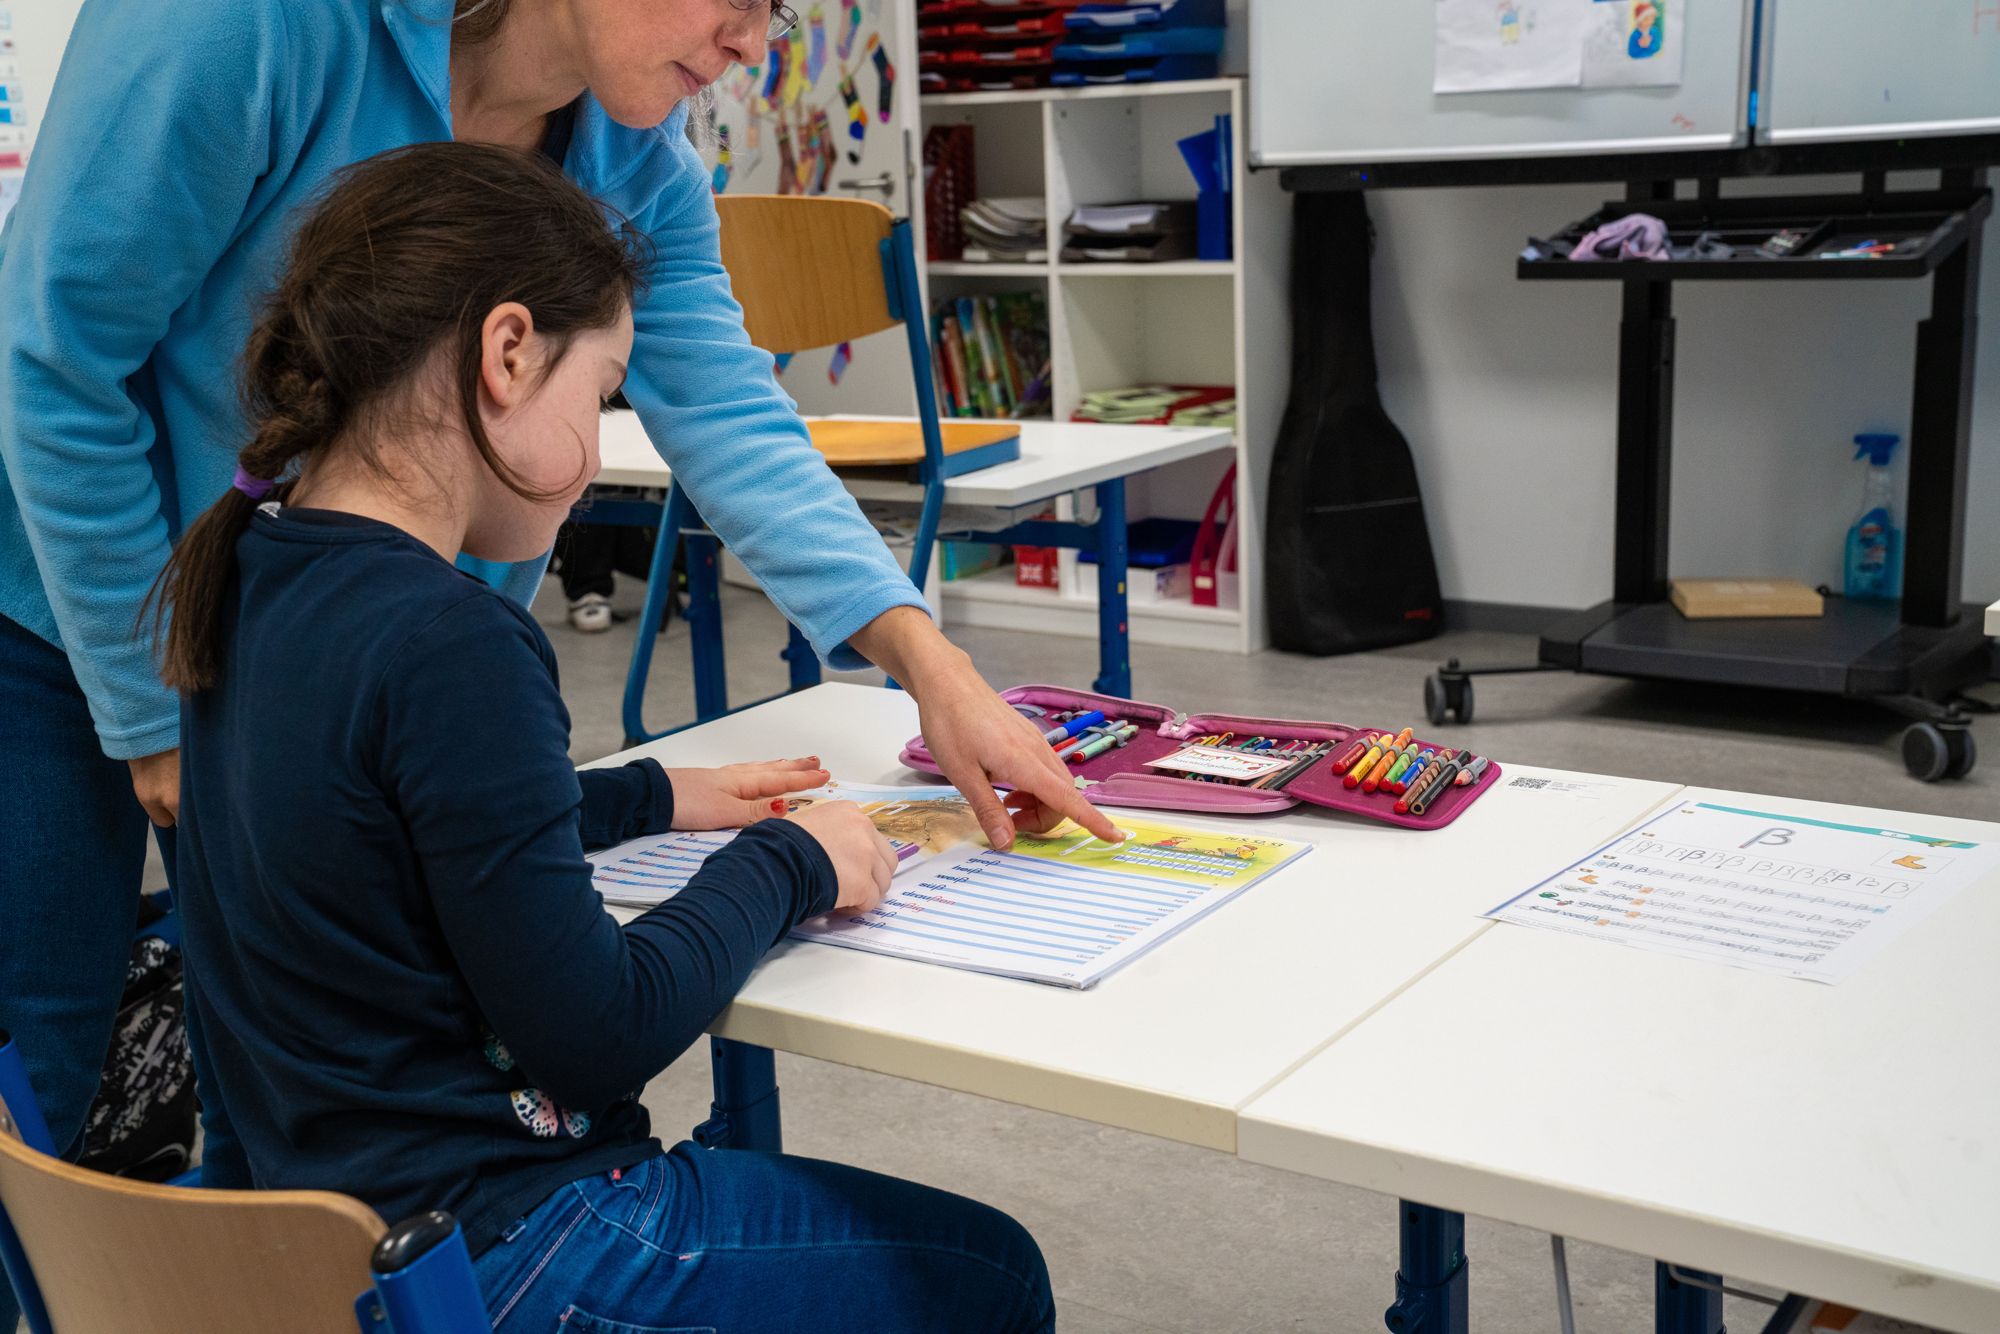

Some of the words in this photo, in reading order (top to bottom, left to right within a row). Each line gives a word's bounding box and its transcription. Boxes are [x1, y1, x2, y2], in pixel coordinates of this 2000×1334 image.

[1738, 827, 1796, 849] ß
[967, 857, 999, 865] groß
[952, 865, 983, 874] heiß
[935, 874, 969, 883] weiß
[918, 882, 947, 891] süß
[1611, 879, 1643, 890] Fuß
[902, 890, 956, 906] draußen
[1594, 890, 1635, 901] Soße
[1577, 901, 1629, 914] gießen
[1561, 911, 1599, 922] weiß
[849, 916, 887, 929] Gruß
